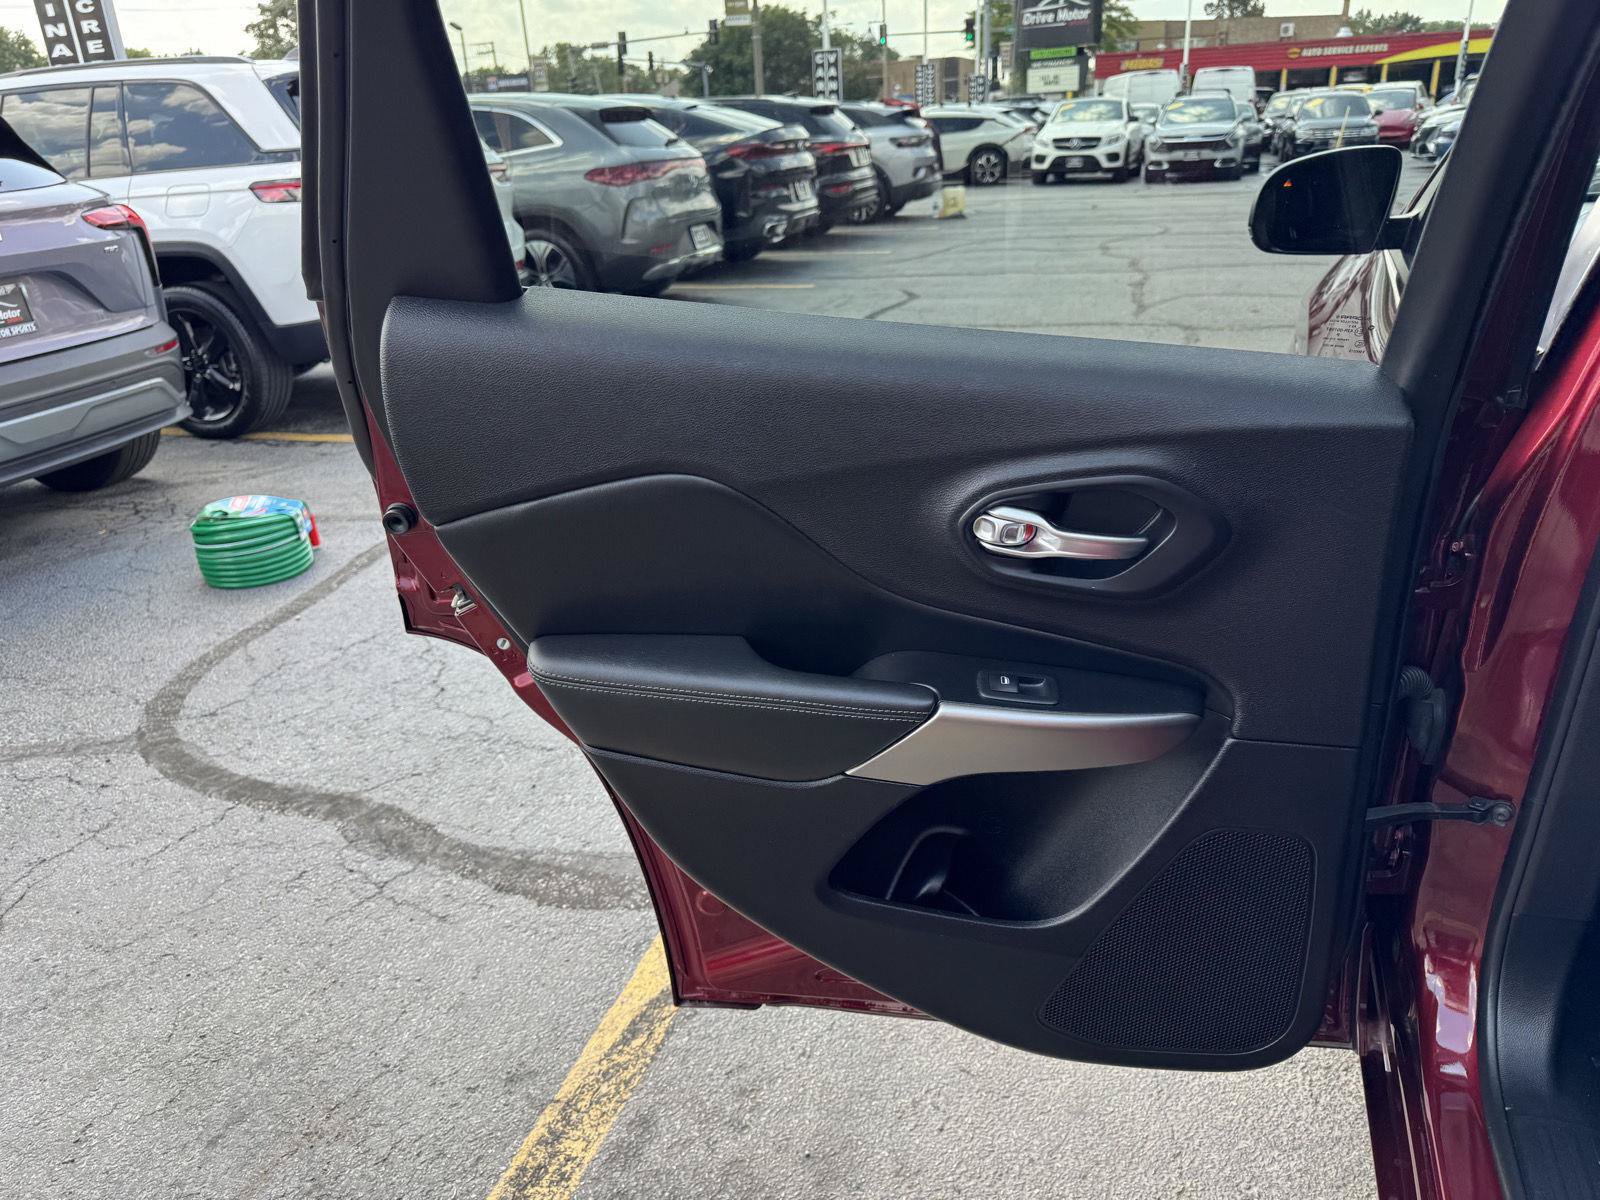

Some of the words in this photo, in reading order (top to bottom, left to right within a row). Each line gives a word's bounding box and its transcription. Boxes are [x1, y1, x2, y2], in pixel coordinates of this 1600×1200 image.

[1022, 12, 1056, 26] Drive
[1056, 7, 1091, 22] Motor
[1301, 47, 1321, 57] AUTO
[11, 320, 37, 335] SPORTS
